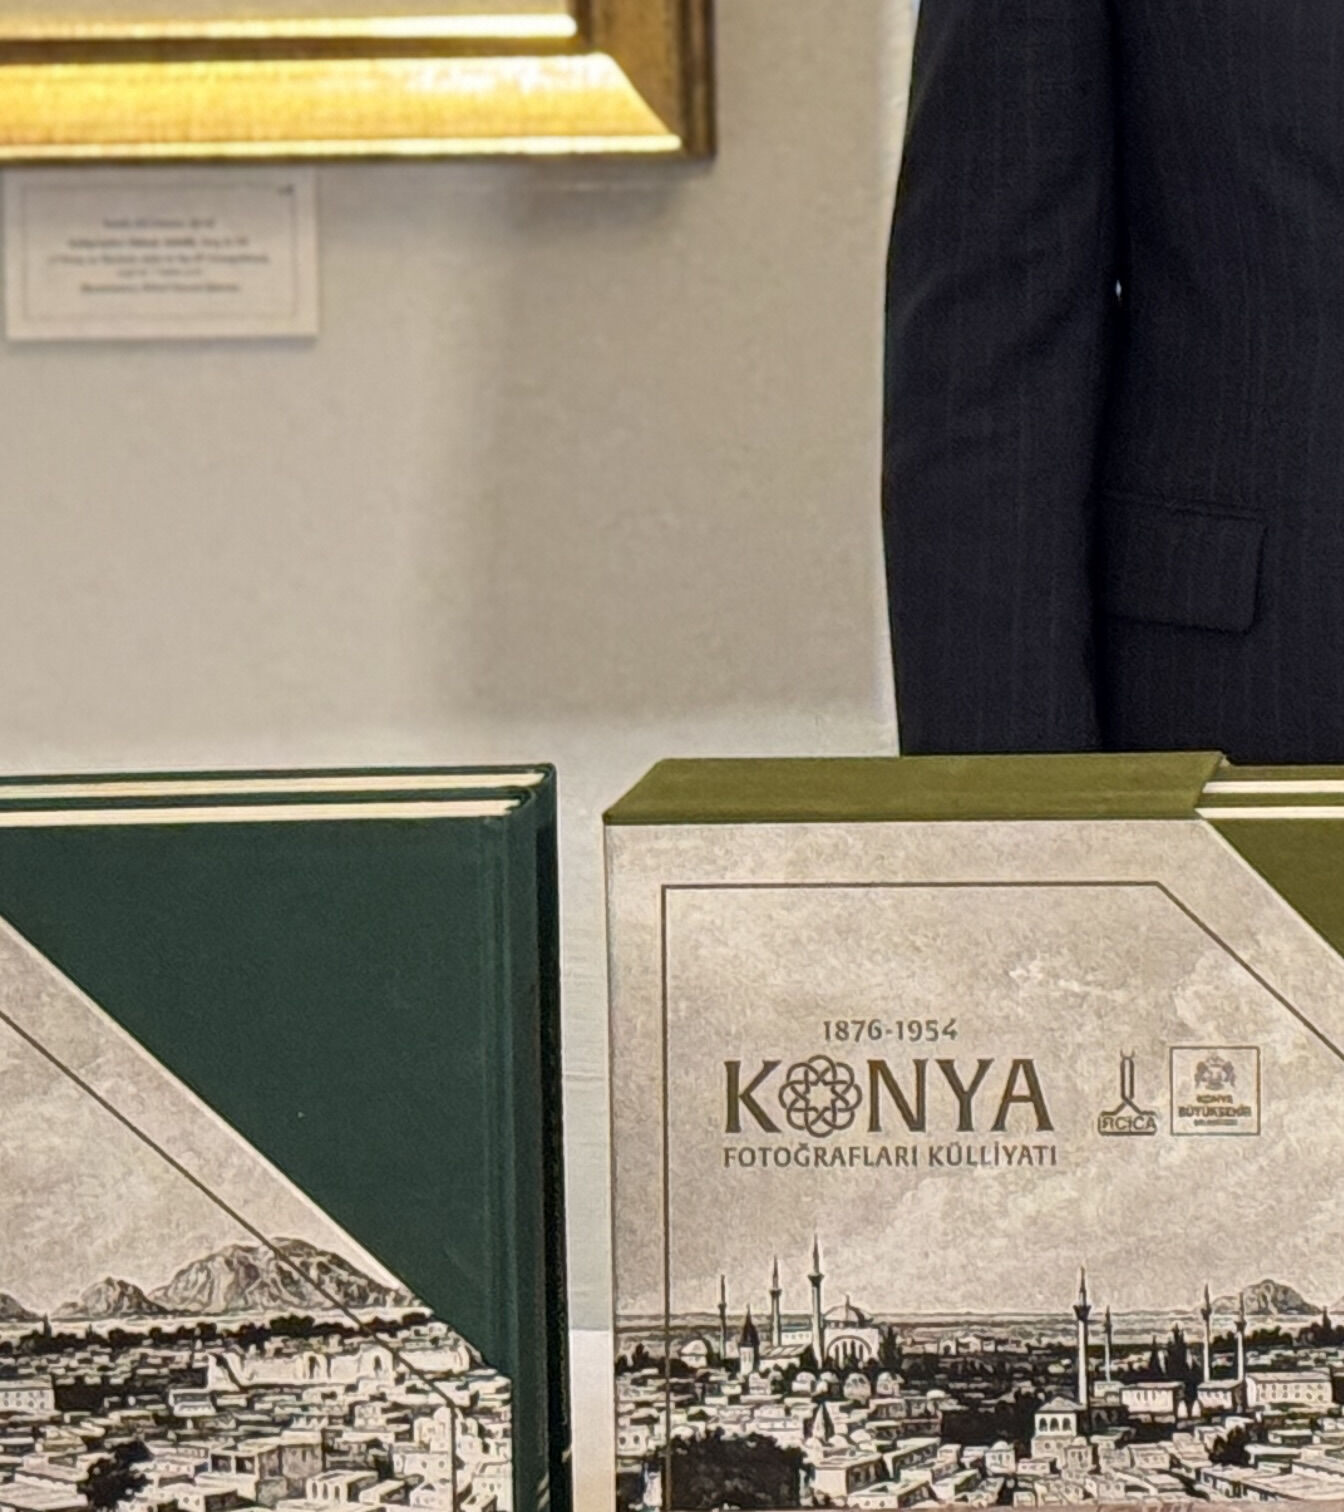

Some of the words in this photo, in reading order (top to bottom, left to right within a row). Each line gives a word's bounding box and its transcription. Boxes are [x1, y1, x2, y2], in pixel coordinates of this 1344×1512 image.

[823, 1018, 959, 1044] 1876-1954
[723, 1054, 1055, 1138] KONYA
[722, 1141, 919, 1170] FOTOĞRAFLARI
[927, 1140, 1058, 1169] KÜLLİYATI
